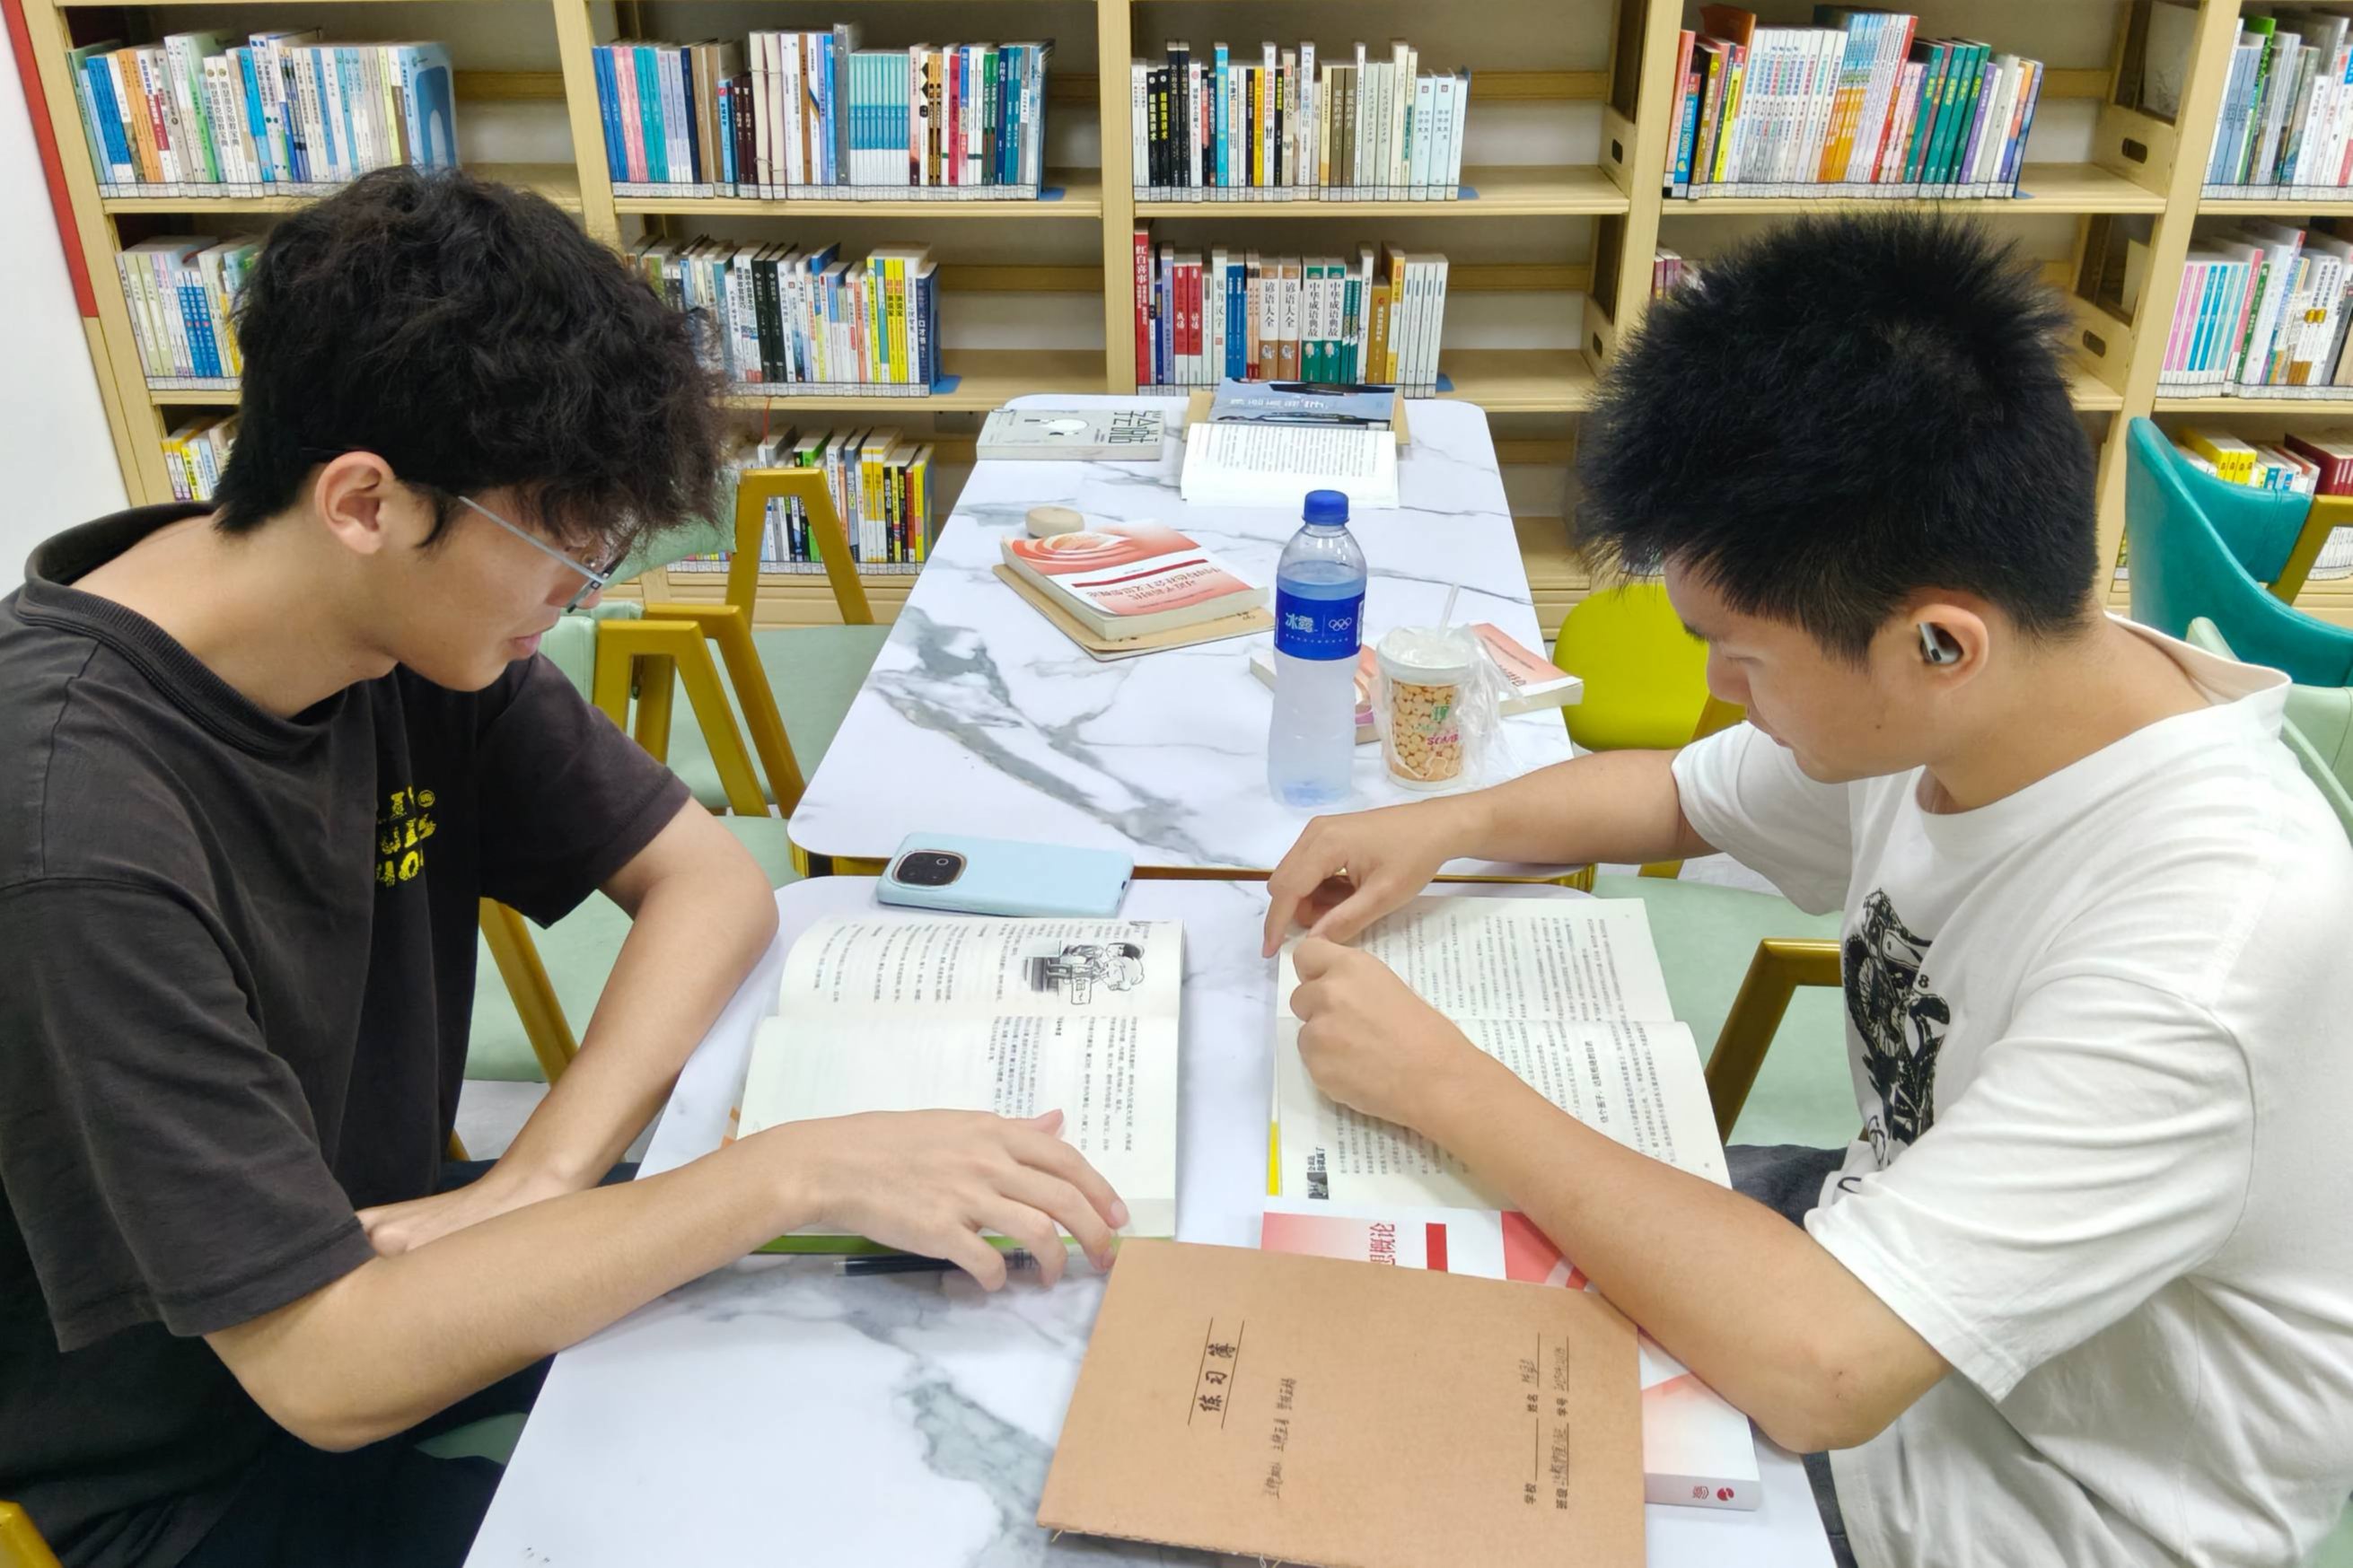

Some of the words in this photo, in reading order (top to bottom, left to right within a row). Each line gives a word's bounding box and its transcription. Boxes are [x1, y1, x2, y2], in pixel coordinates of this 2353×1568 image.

[1135, 245, 1147, 285] 红白喜事
[1215, 279, 1225, 329] 魅力汉字
[1264, 282, 1276, 328] 谚语大全
[1285, 282, 1295, 328] 谚语大全
[1307, 282, 1321, 337] 中华成语典故
[1328, 282, 1341, 337] 中华成语典故
[1285, 612, 1314, 634] 冰露
[1198, 1343, 1236, 1413] 练习簿
[1527, 1393, 1539, 1414] 姓名
[1556, 1397, 1568, 1417] 学号
[1524, 1483, 1537, 1506] 学校
